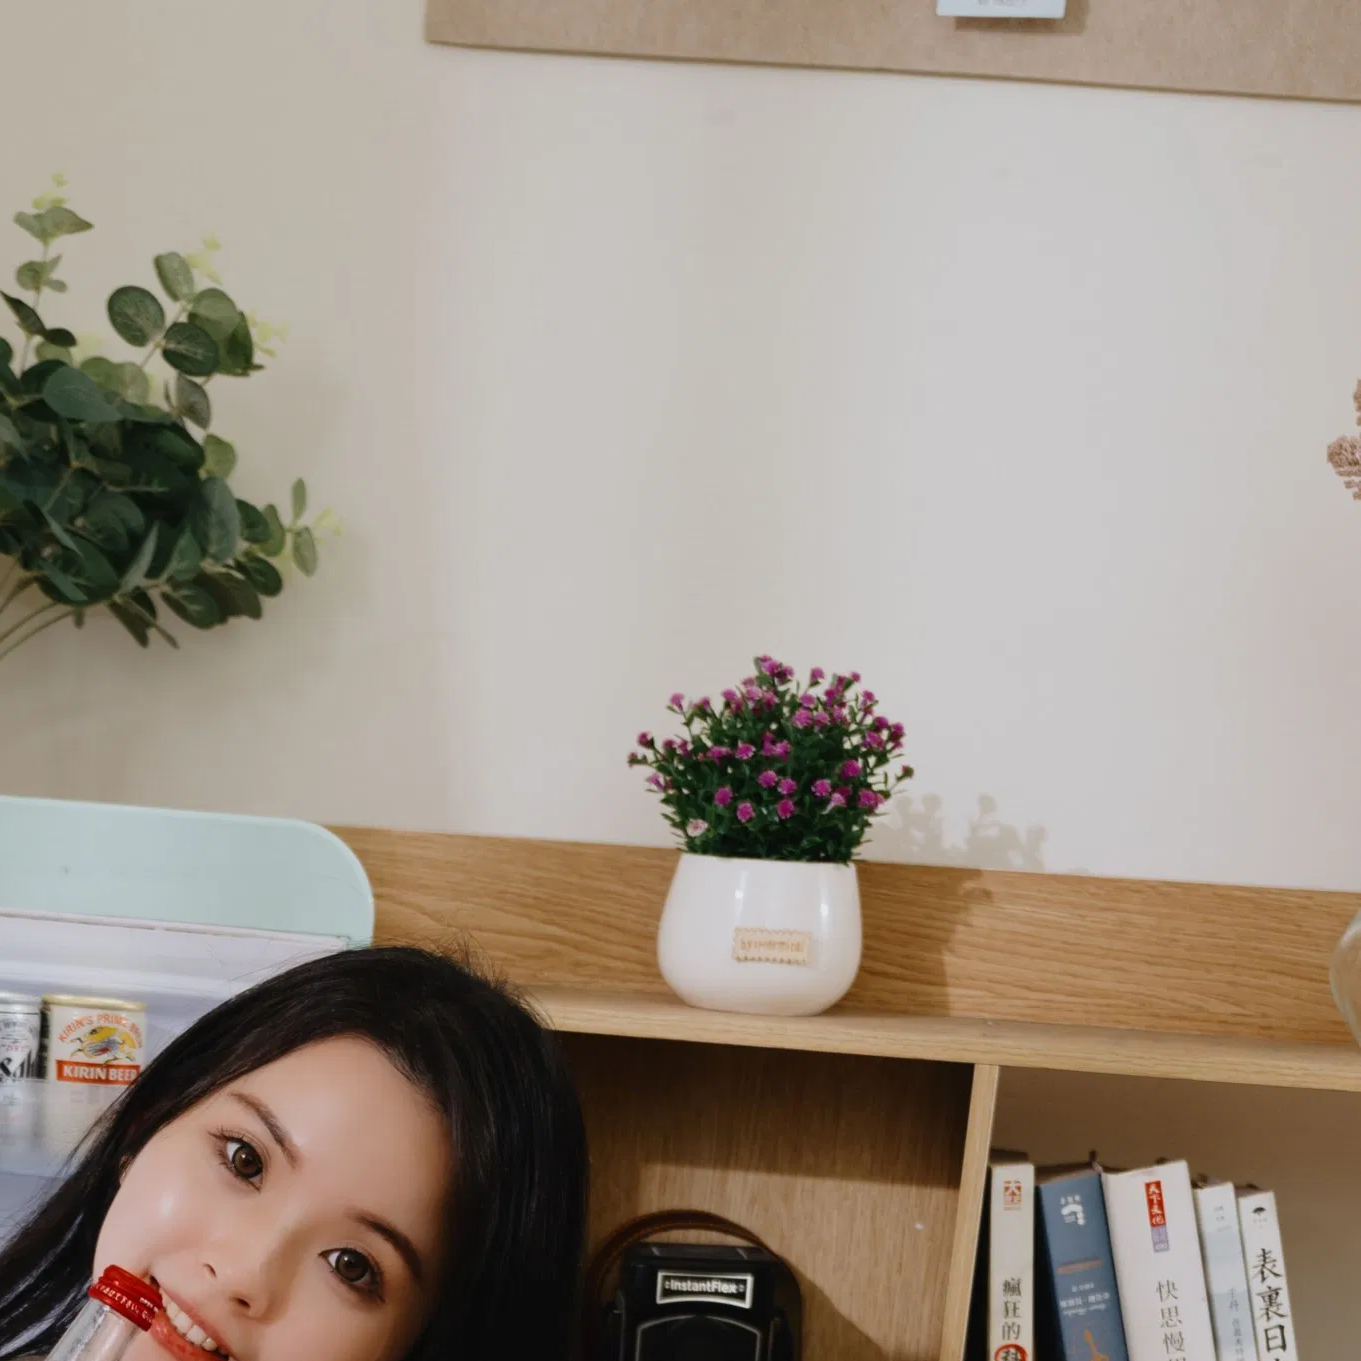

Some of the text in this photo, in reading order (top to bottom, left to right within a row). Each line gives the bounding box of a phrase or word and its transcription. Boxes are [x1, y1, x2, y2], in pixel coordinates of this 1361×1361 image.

[63, 1065, 107, 1080] KIRIN
[1148, 1183, 1166, 1225] 天下文化
[670, 1279, 739, 1294] InstantFlex
